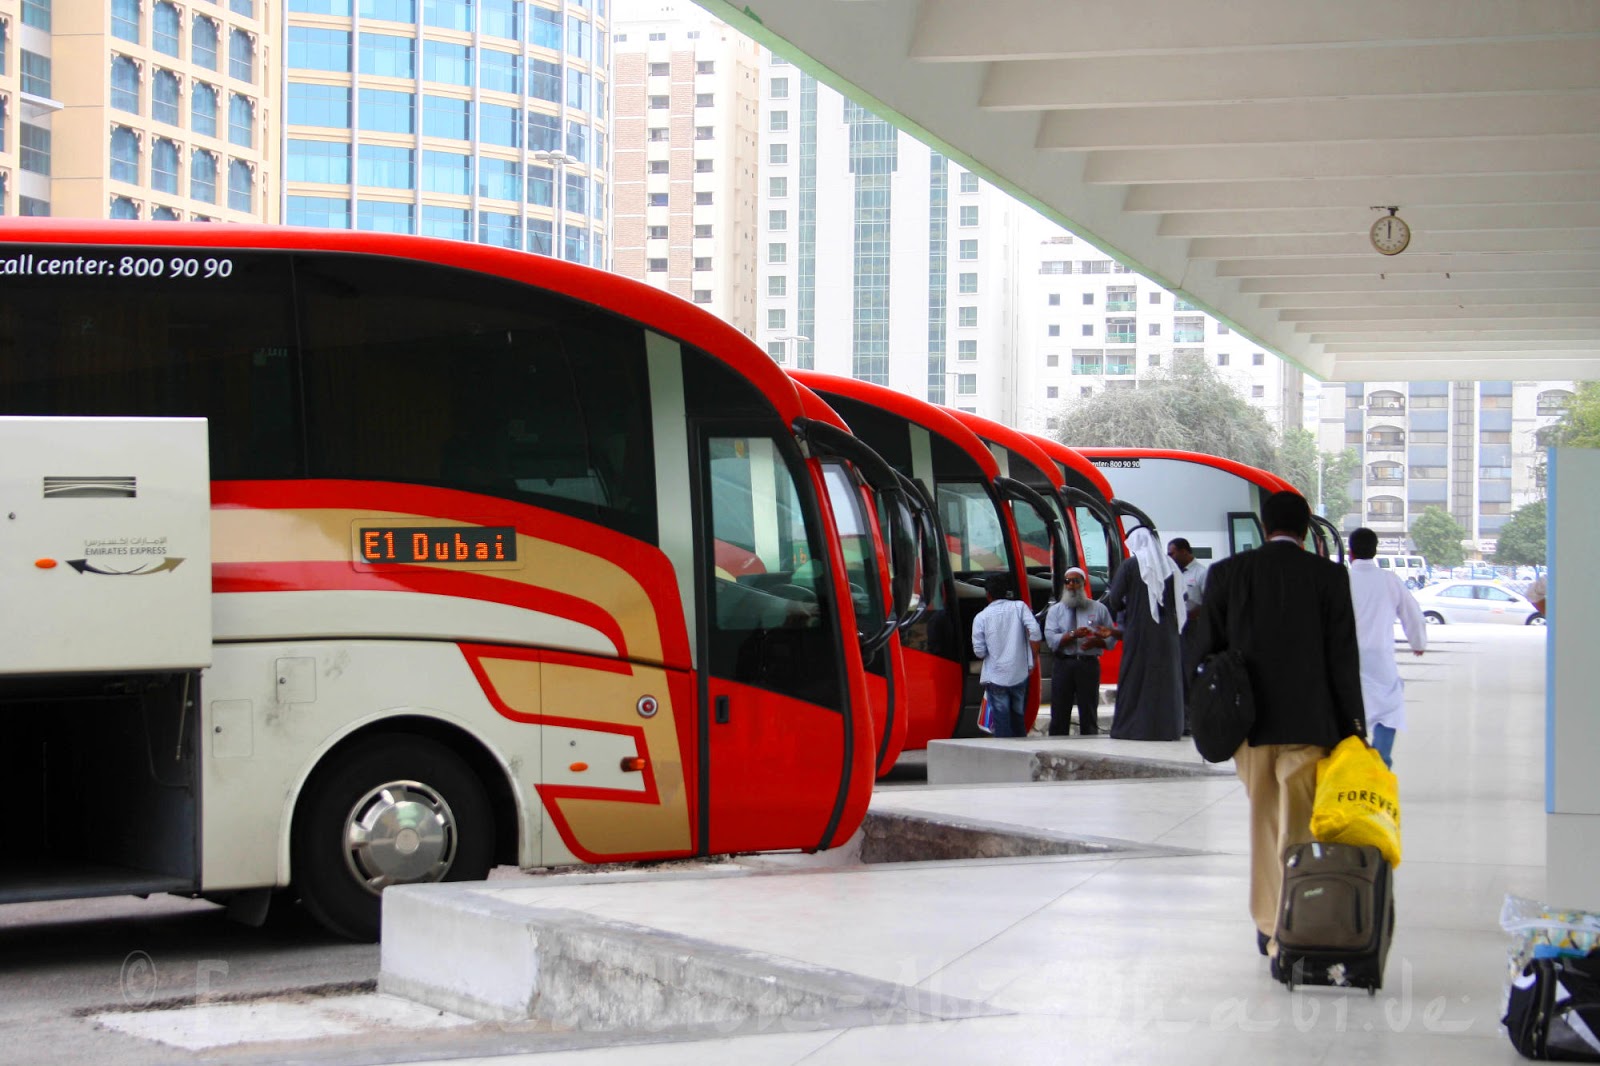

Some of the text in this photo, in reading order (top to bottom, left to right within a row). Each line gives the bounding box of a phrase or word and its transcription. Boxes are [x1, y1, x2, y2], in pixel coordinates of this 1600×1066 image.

[37, 256, 114, 276] center:
[119, 256, 164, 277] 800
[170, 258, 199, 277] 90
[204, 258, 233, 278] 90
[1110, 460, 1122, 468] 800
[1123, 460, 1131, 468] 90
[85, 547, 167, 555] EMIRATES EXPRESS
[364, 531, 504, 560] E1 Dubai
